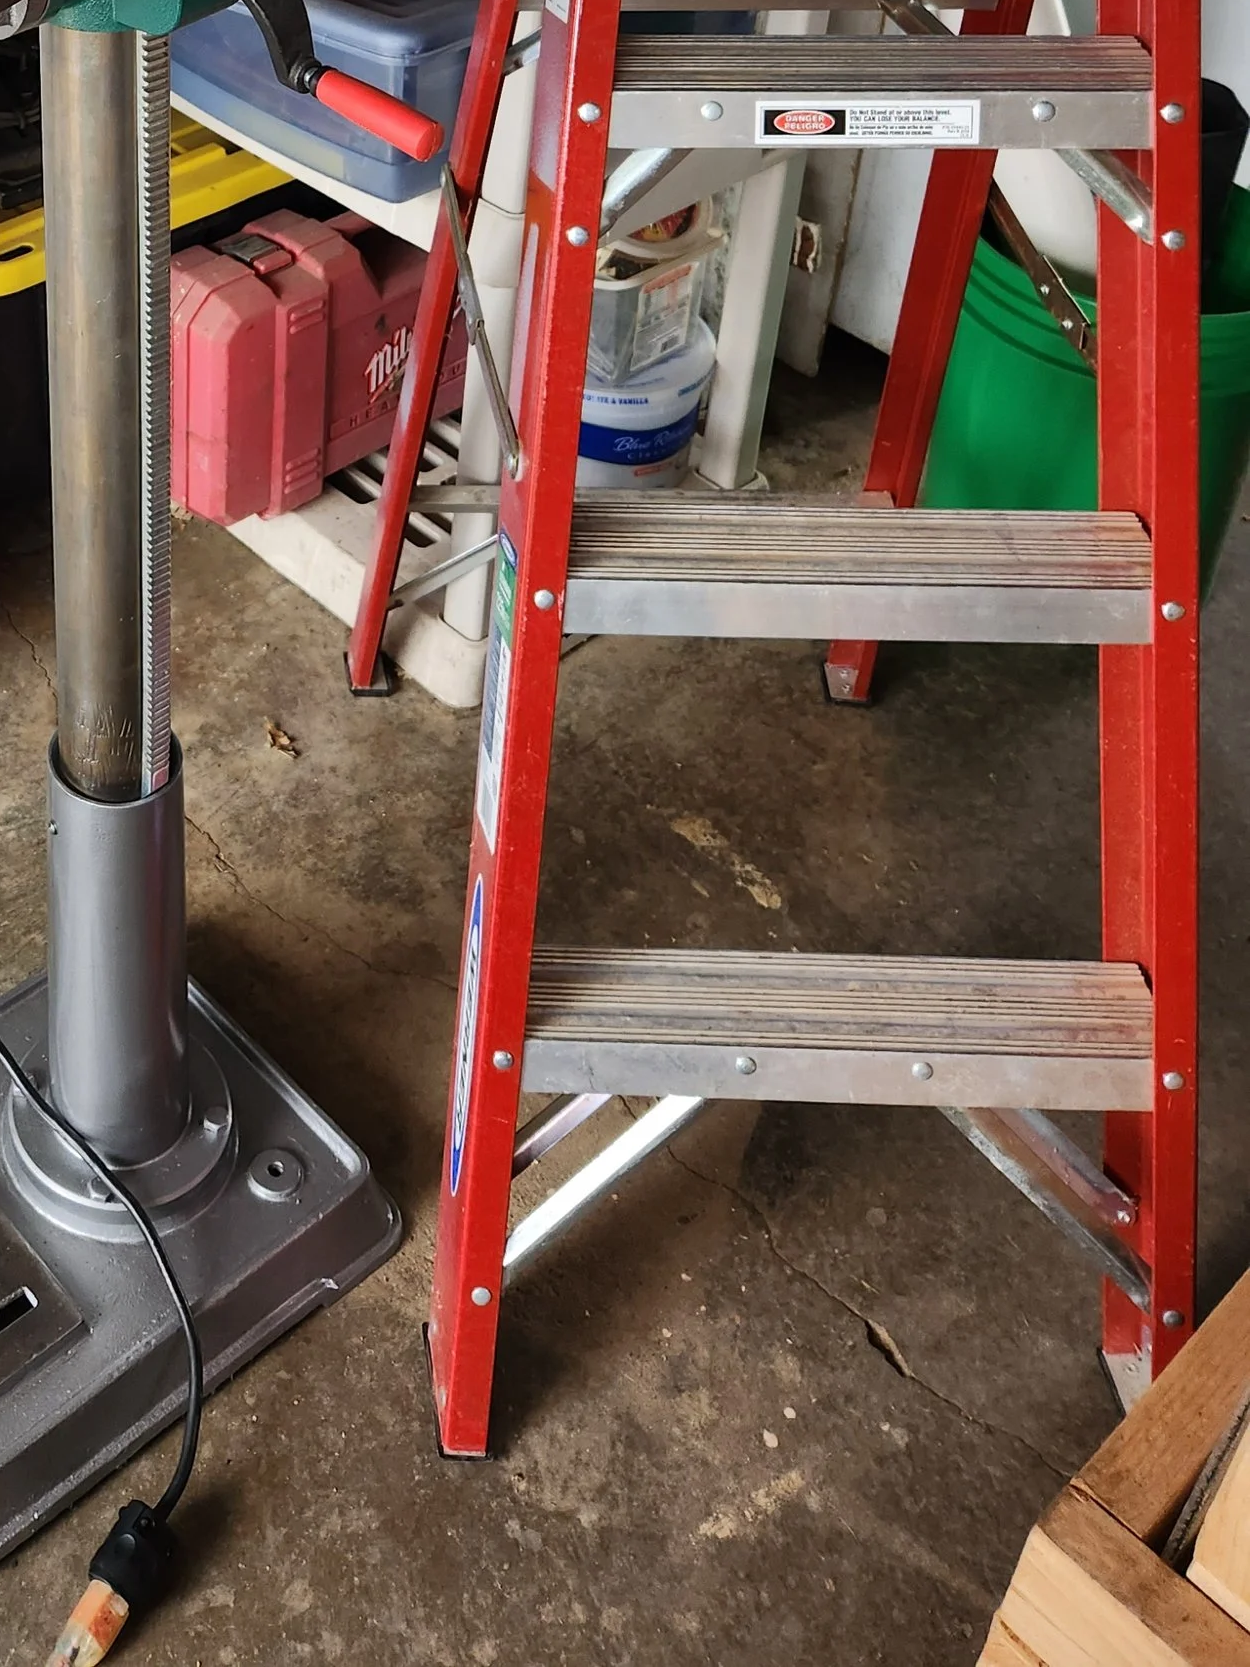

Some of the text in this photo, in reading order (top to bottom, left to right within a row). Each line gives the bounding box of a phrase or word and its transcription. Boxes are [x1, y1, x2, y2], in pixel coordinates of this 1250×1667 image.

[785, 114, 824, 122] DANGER
[784, 122, 826, 130] PELIGRO
[618, 397, 649, 405] VANILLA
[456, 950, 476, 1132] WERNER
